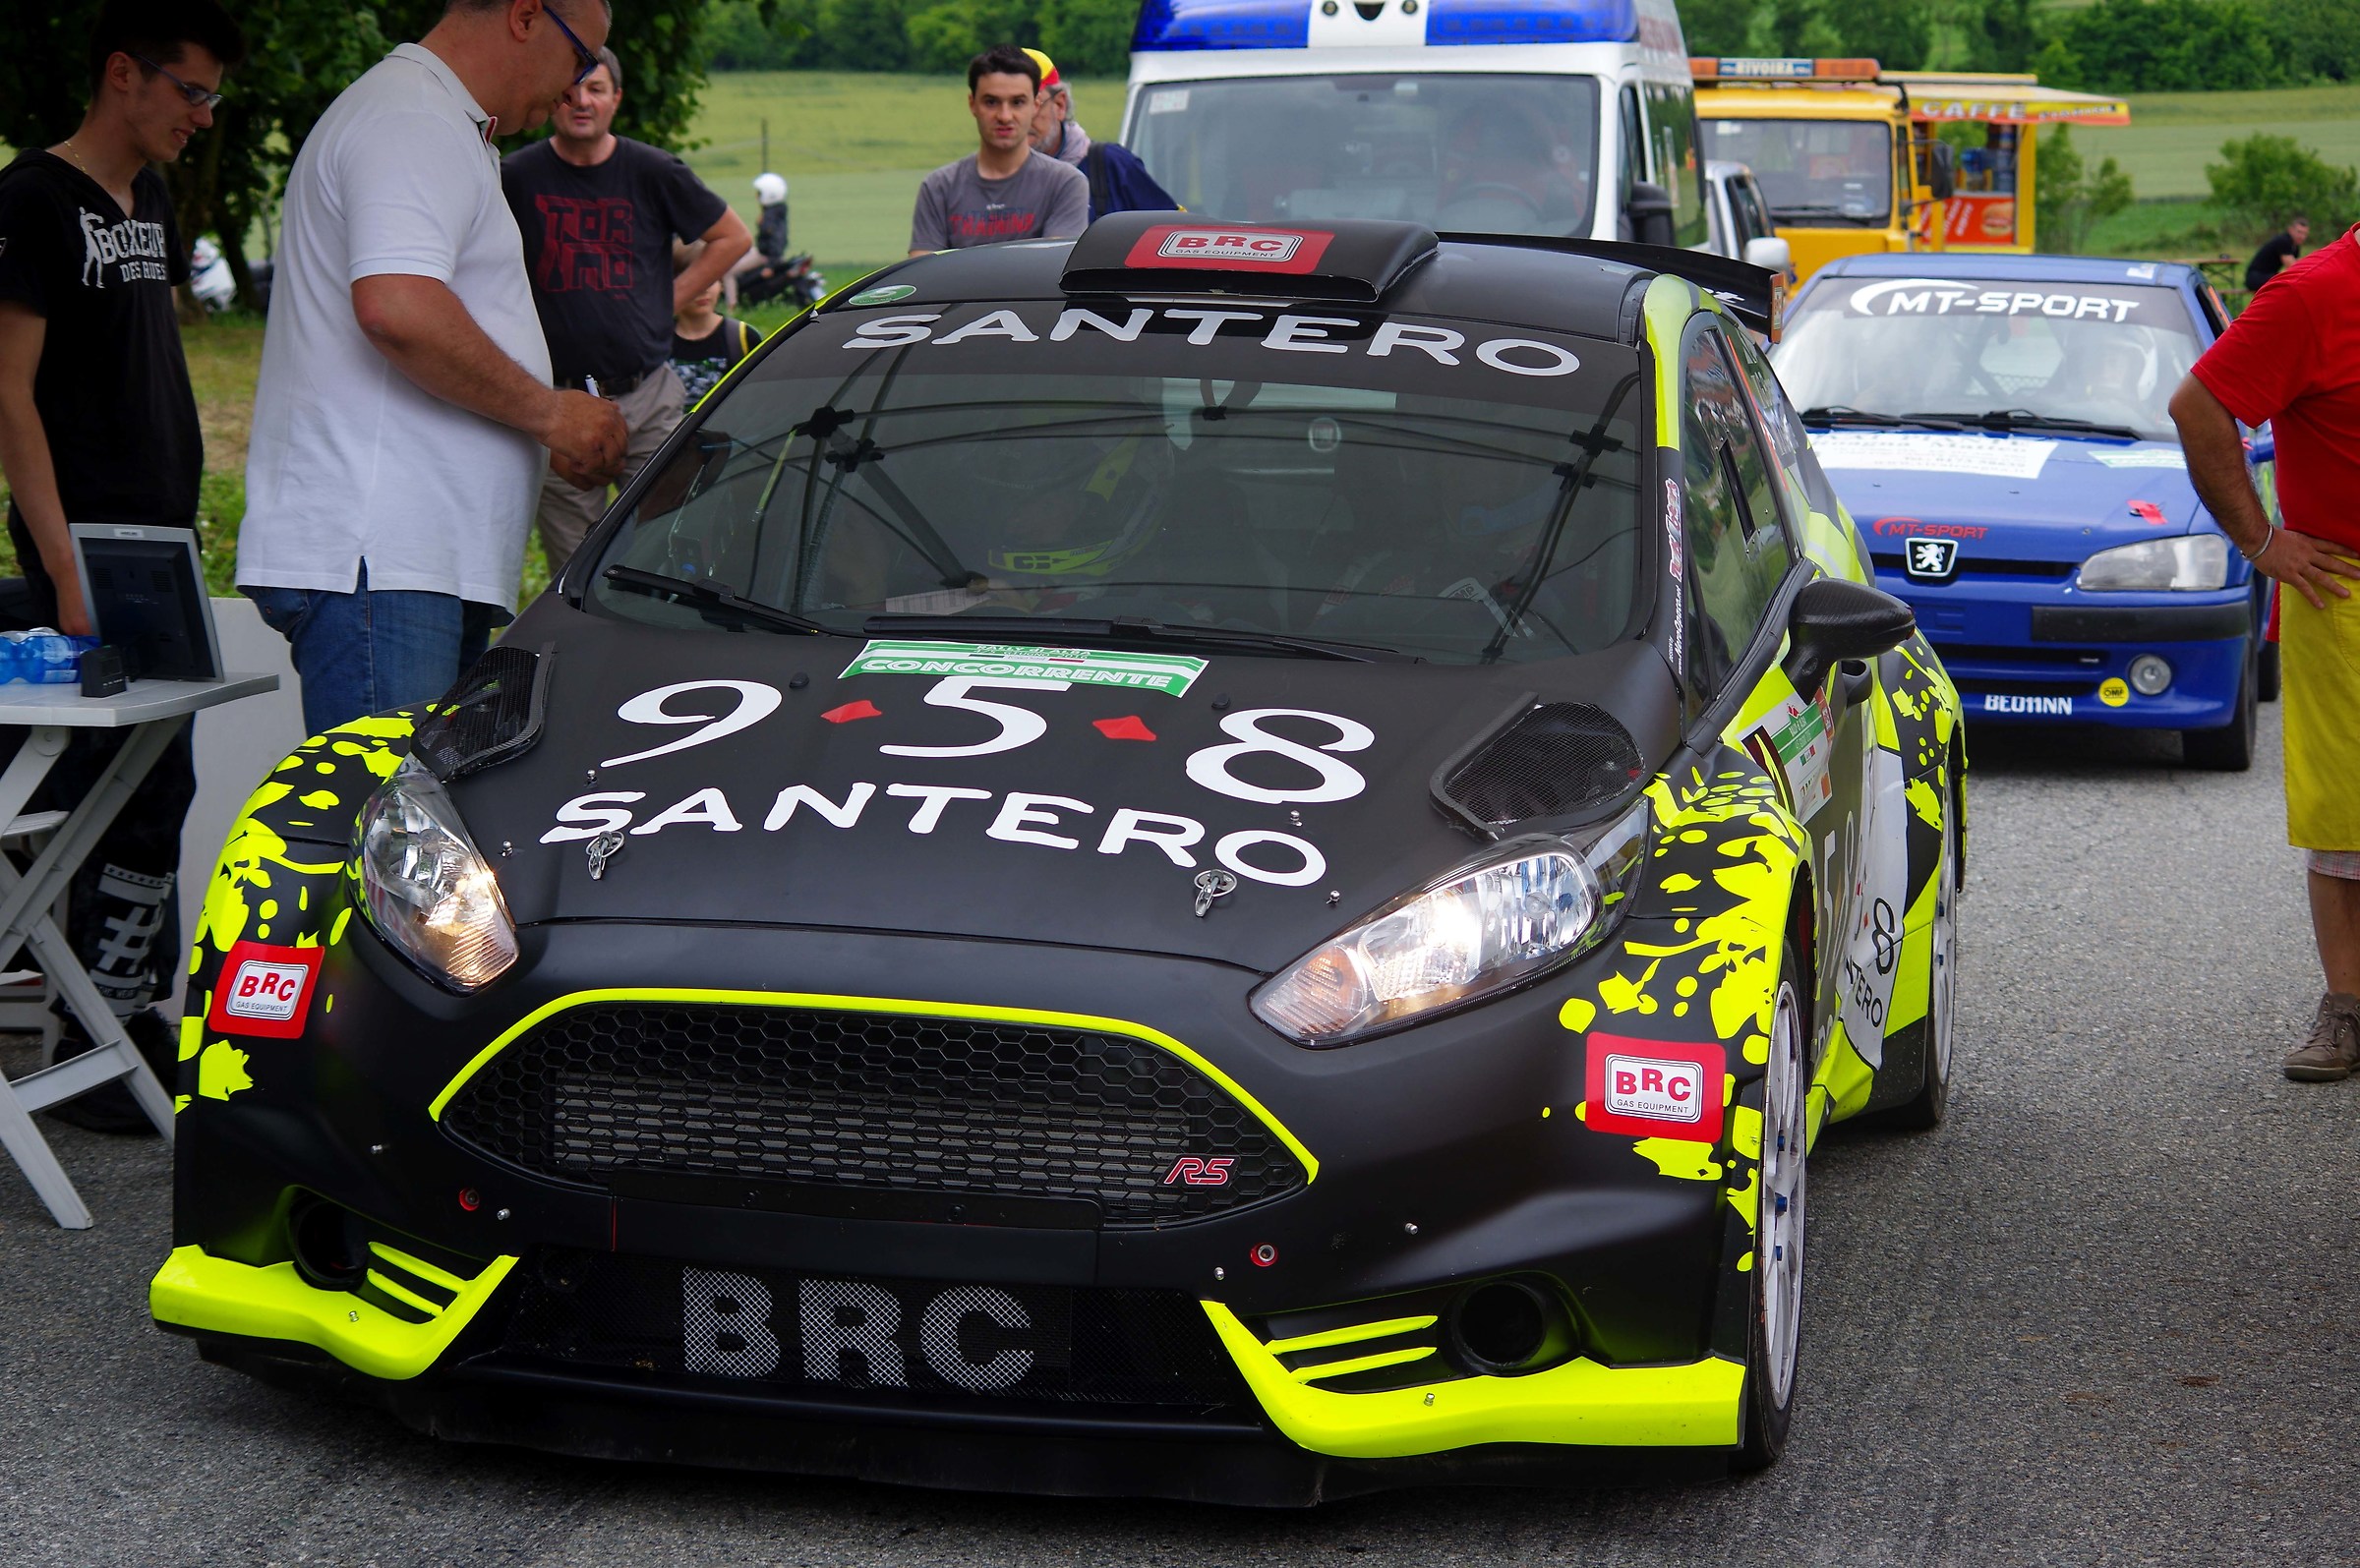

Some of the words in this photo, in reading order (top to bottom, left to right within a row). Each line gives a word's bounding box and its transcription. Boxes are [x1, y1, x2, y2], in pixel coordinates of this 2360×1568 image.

[93, 219, 165, 263] BOXEUR
[1176, 235, 1283, 252] BRC
[120, 261, 142, 282] DES
[1887, 290, 2140, 322] MT-SPORT
[843, 308, 1580, 377] SANTERO
[1887, 523, 1988, 539] MT-SPORT
[860, 660, 1173, 688] CONCORRENTE
[601, 679, 783, 768] 9
[880, 675, 1072, 757] 5
[1186, 708, 1376, 804] 8
[540, 783, 1327, 887] SANTERO
[238, 972, 296, 1002] BRC
[1845, 954, 1883, 1027] NTERO
[252, 1003, 287, 1013] EQUIPMENT
[1617, 1068, 1691, 1101] BRC
[1617, 1098, 1635, 1108] GAS
[1637, 1101, 1688, 1114] EQUIPMENT
[682, 1265, 1034, 1392] BRC
